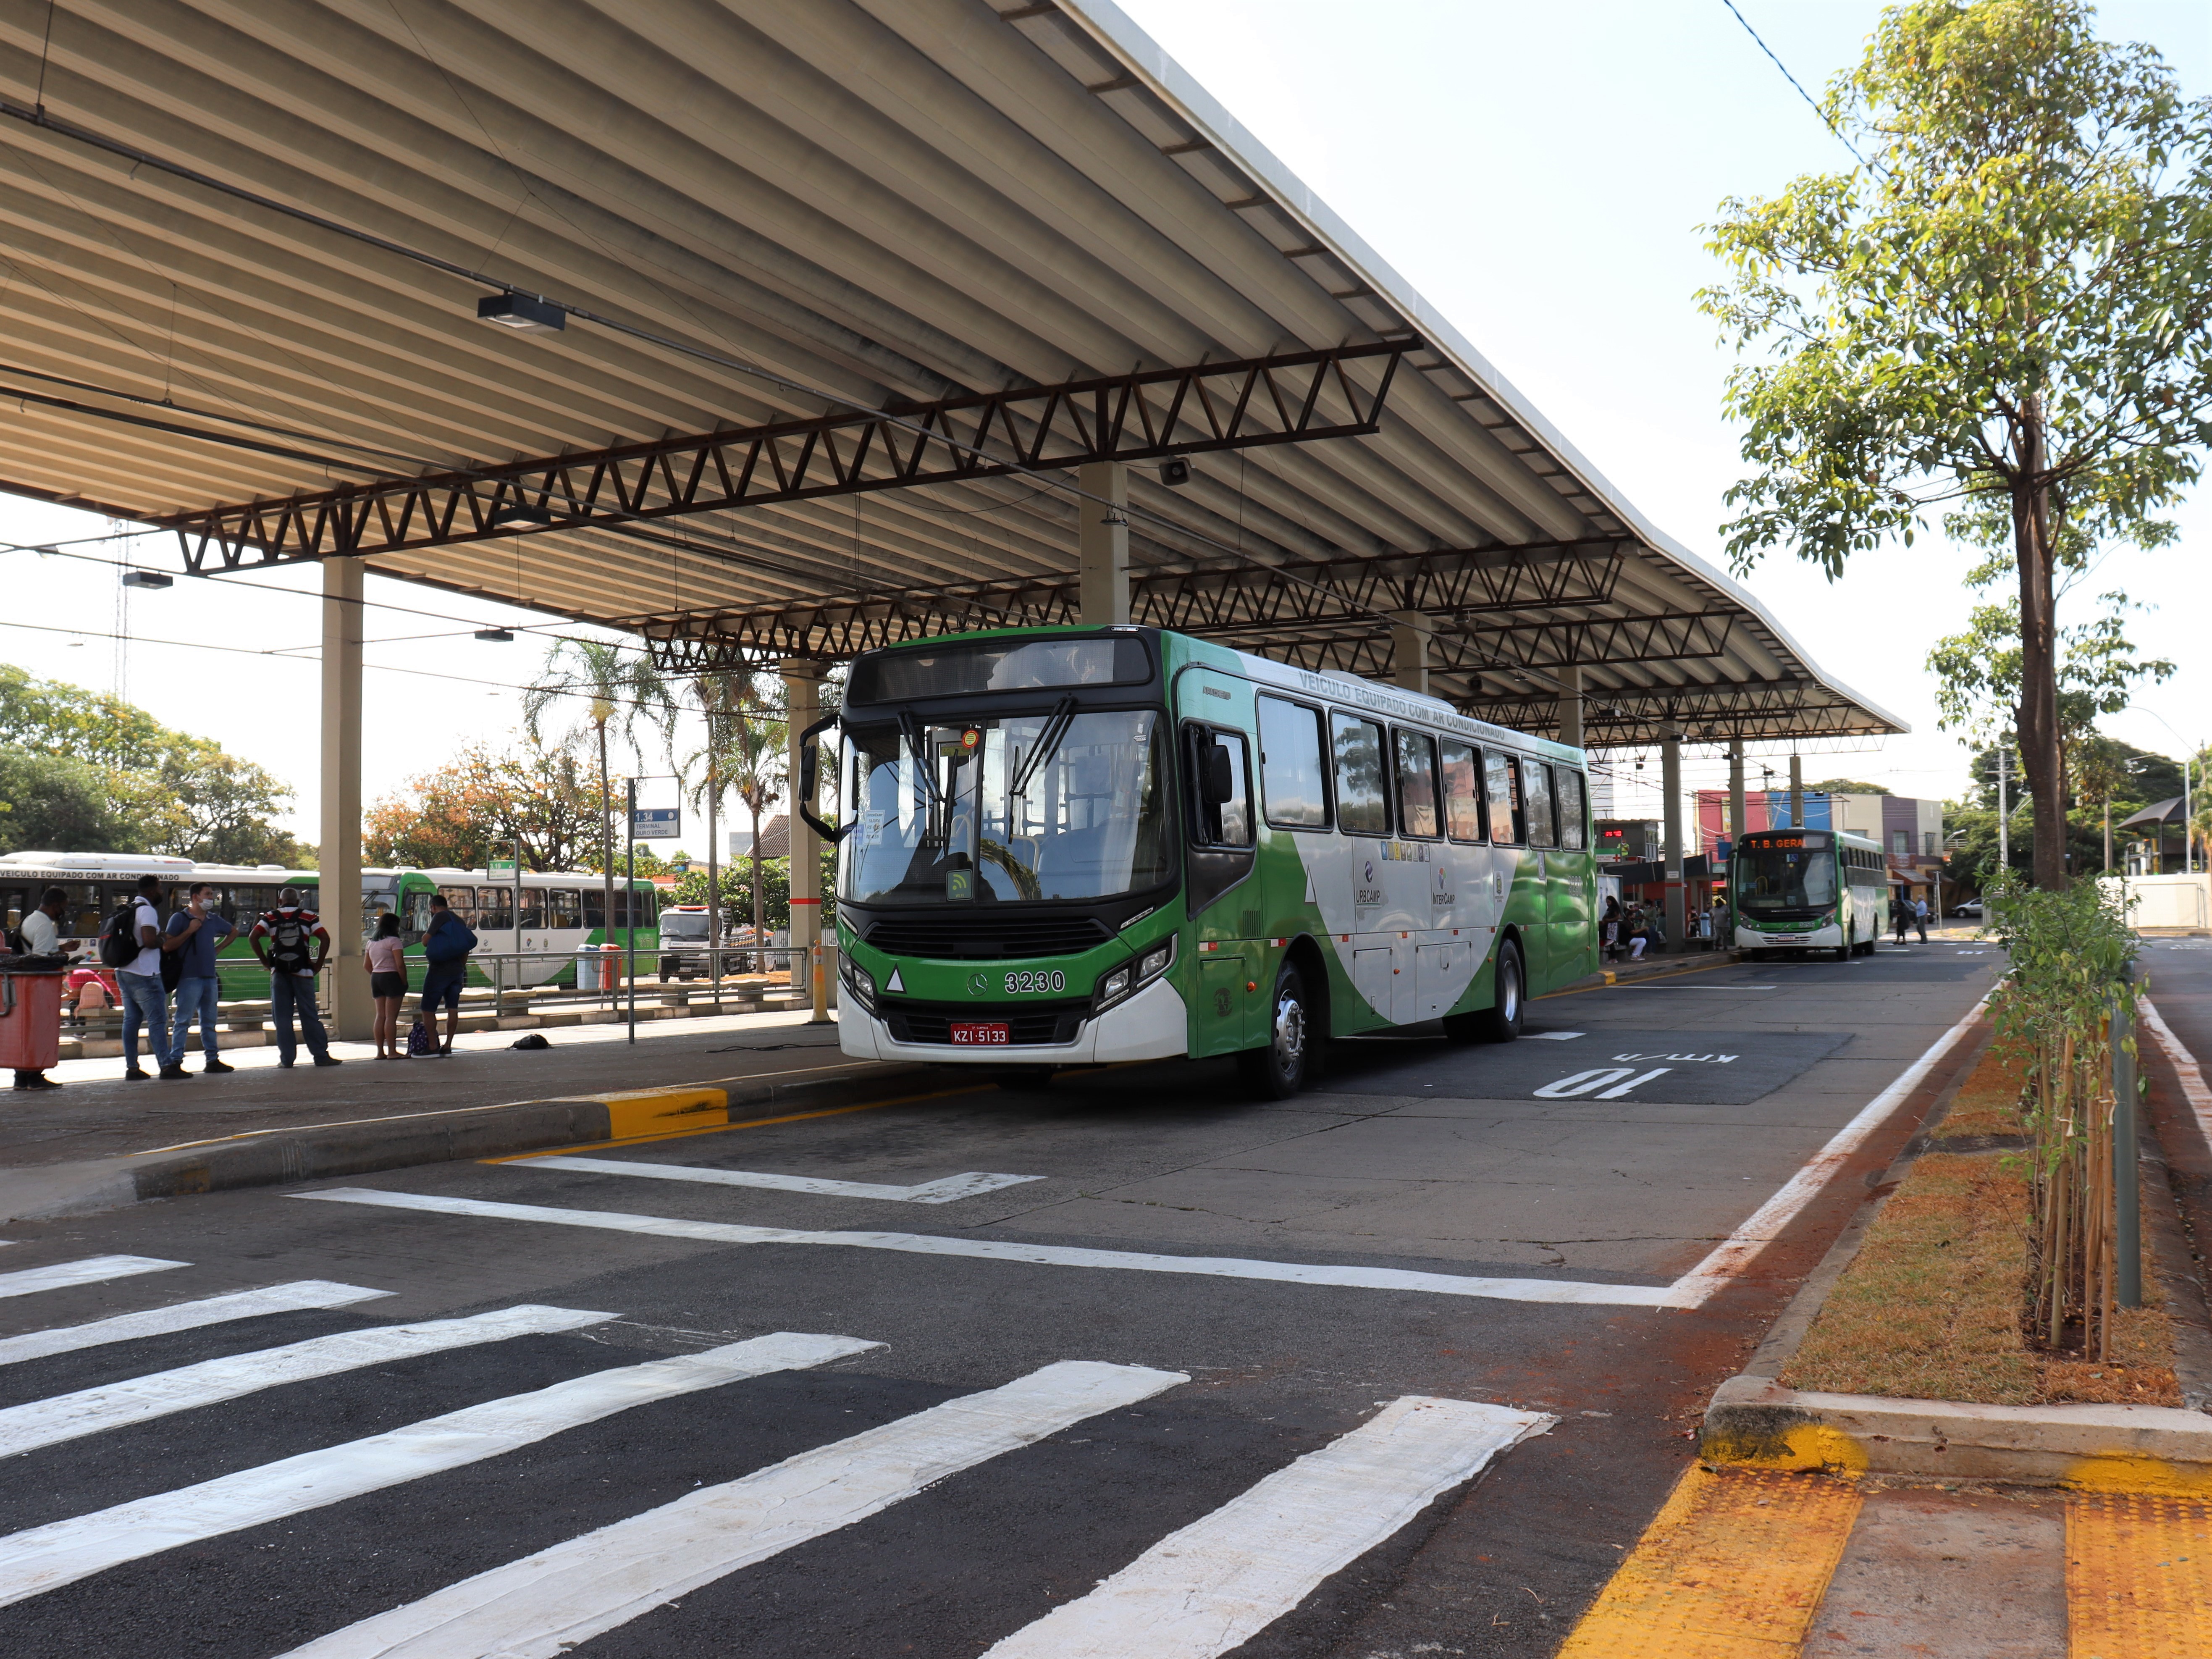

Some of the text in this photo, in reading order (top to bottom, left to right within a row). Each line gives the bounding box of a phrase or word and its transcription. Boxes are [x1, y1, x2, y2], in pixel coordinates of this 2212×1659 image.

[1299, 671, 1504, 740] VEICULO EQUIPADO COM AR CONDICIONADO
[635, 812, 653, 822] 1.34
[1776, 839, 1807, 848] GERAL
[1356, 890, 1380, 903] URBCAMP
[1005, 970, 1065, 994] 3230
[1533, 1068, 1674, 1099] 10
